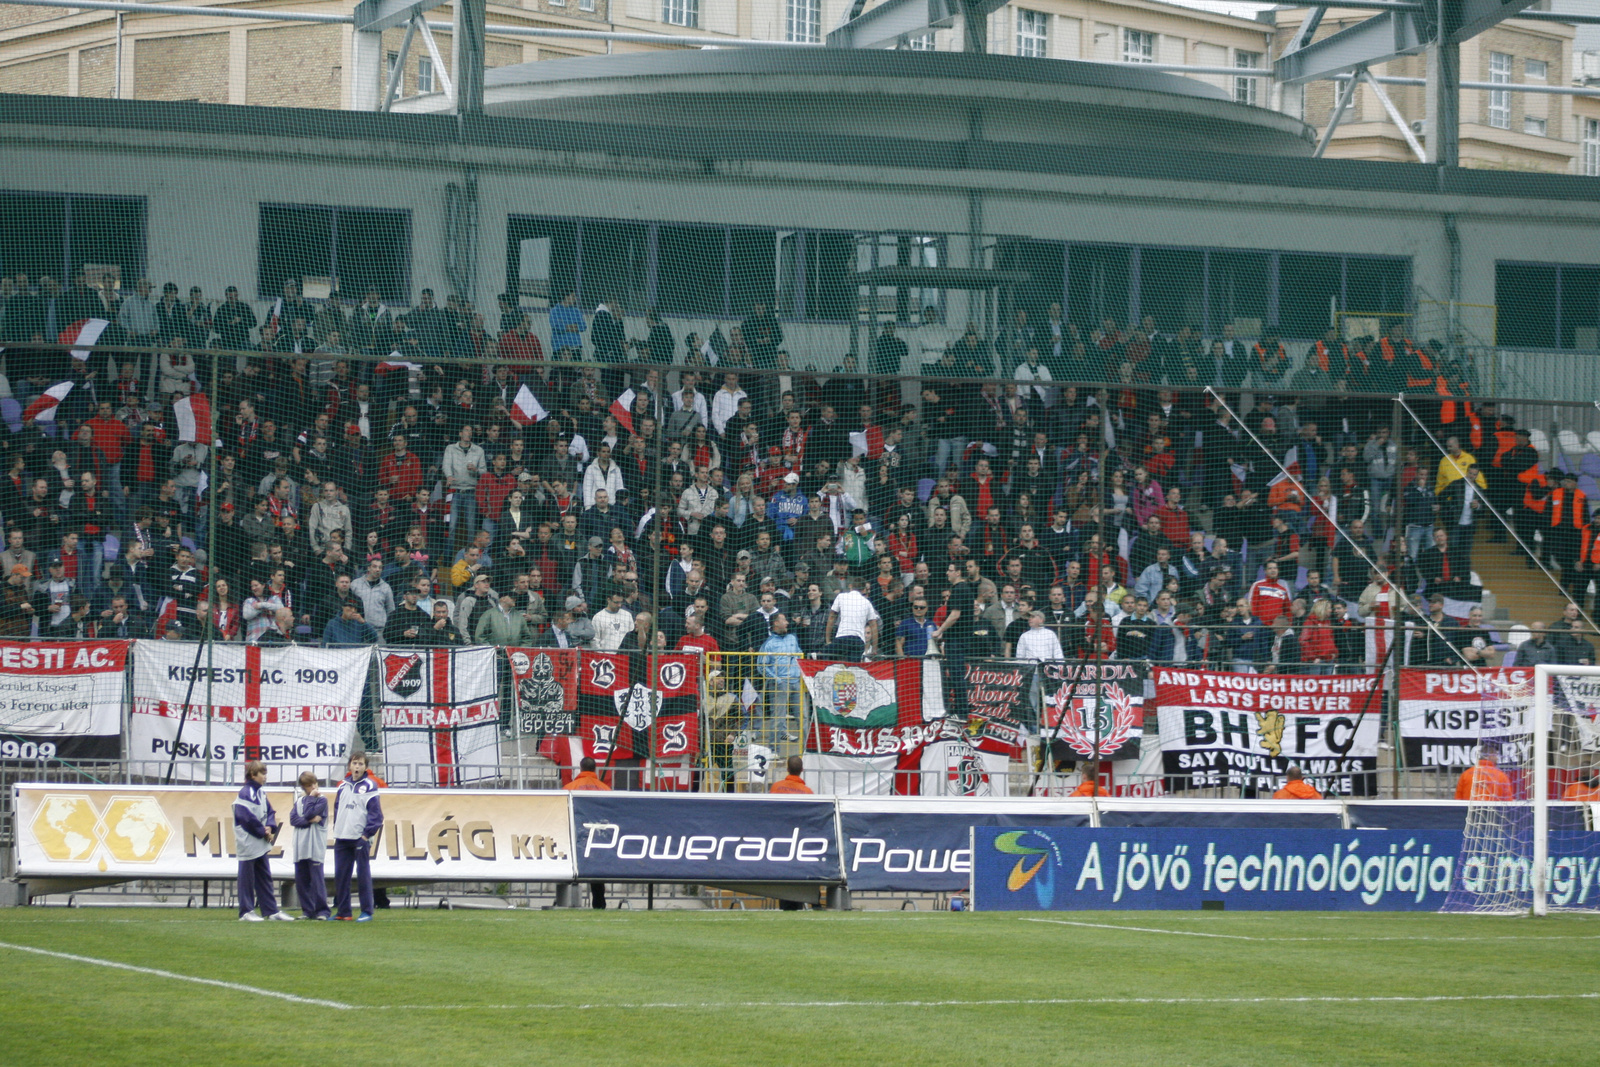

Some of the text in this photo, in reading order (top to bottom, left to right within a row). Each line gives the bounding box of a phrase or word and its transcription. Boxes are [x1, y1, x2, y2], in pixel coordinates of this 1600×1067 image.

[0, 647, 114, 669] ESTI AC.
[259, 669, 287, 685] AC.
[294, 668, 339, 685] 1909
[402, 679, 421, 688] 1909
[1158, 671, 1378, 693] AND THOUGH NOTHING
[36, 682, 78, 694] Kispest
[11, 699, 58, 712] Ferenc
[61, 699, 89, 710] utca
[134, 697, 358, 723] WE SHALL NOT BE MOVE
[1190, 689, 1351, 711] LASTS FOREVER
[381, 702, 499, 726] MATRAALJA
[545, 713, 572, 721] VESPA
[1424, 706, 1529, 730] KISPEST
[987, 725, 1018, 742] 1909
[1183, 709, 1356, 754] BH FC
[0, 741, 56, 761] 909
[152, 738, 226, 760] PUSKAS
[232, 743, 309, 761] FERENC
[1421, 741, 1532, 766] HUNRY
[1179, 751, 1364, 775] SAY YOU'LL ALWAYS
[1192, 769, 1221, 786] BE
[1257, 776, 1352, 793] PLESURE
[182, 815, 286, 860] MZ
[510, 833, 569, 861] Kft.
[1075, 841, 1104, 891] A
[1112, 841, 1191, 903] jövő
[1203, 836, 1454, 905] technológiája
[1462, 856, 1487, 893] a
[1495, 856, 1600, 906] magy
